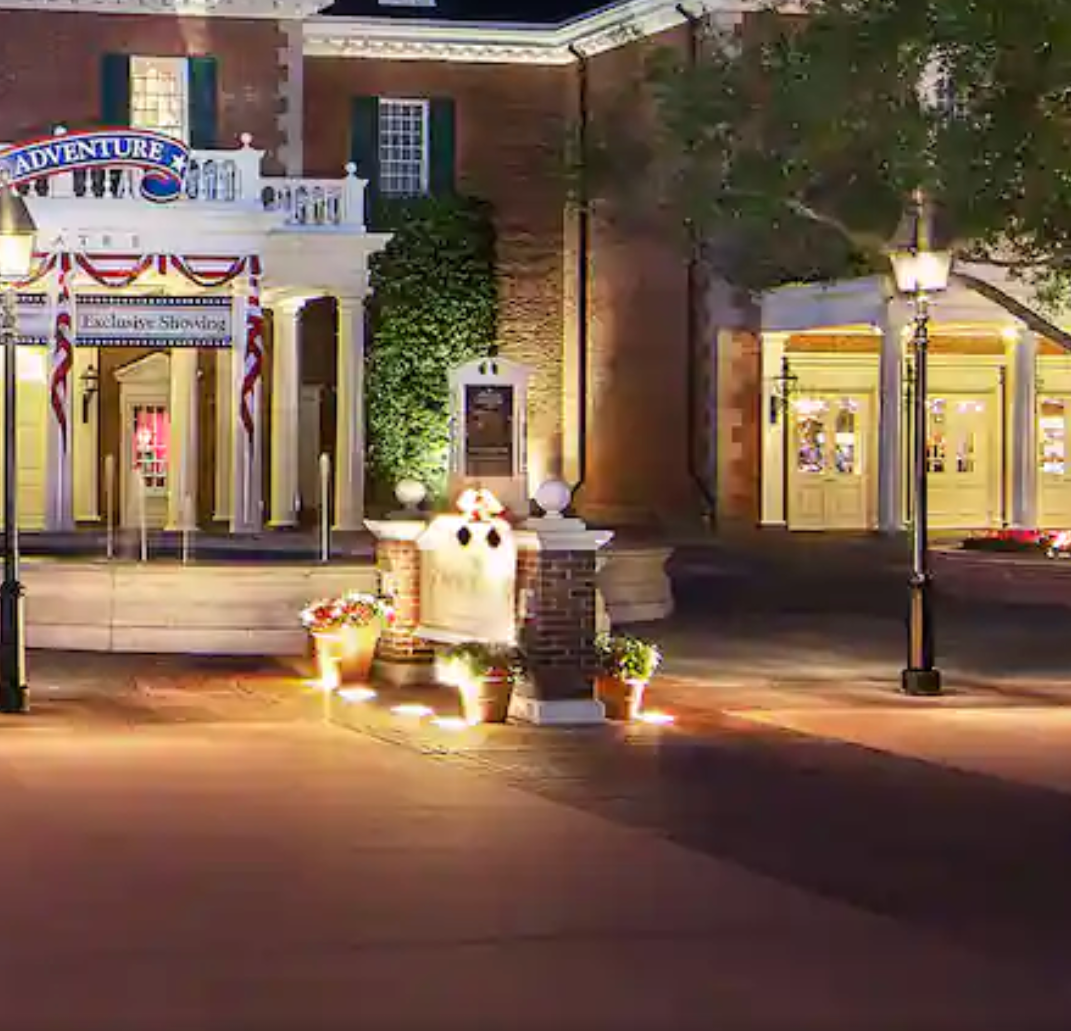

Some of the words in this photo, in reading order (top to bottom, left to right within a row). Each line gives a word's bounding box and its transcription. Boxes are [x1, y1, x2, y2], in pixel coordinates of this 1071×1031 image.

[15, 137, 164, 174] ADVENTURE
[82, 312, 156, 329] Exclusive
[160, 315, 226, 331] Showing
